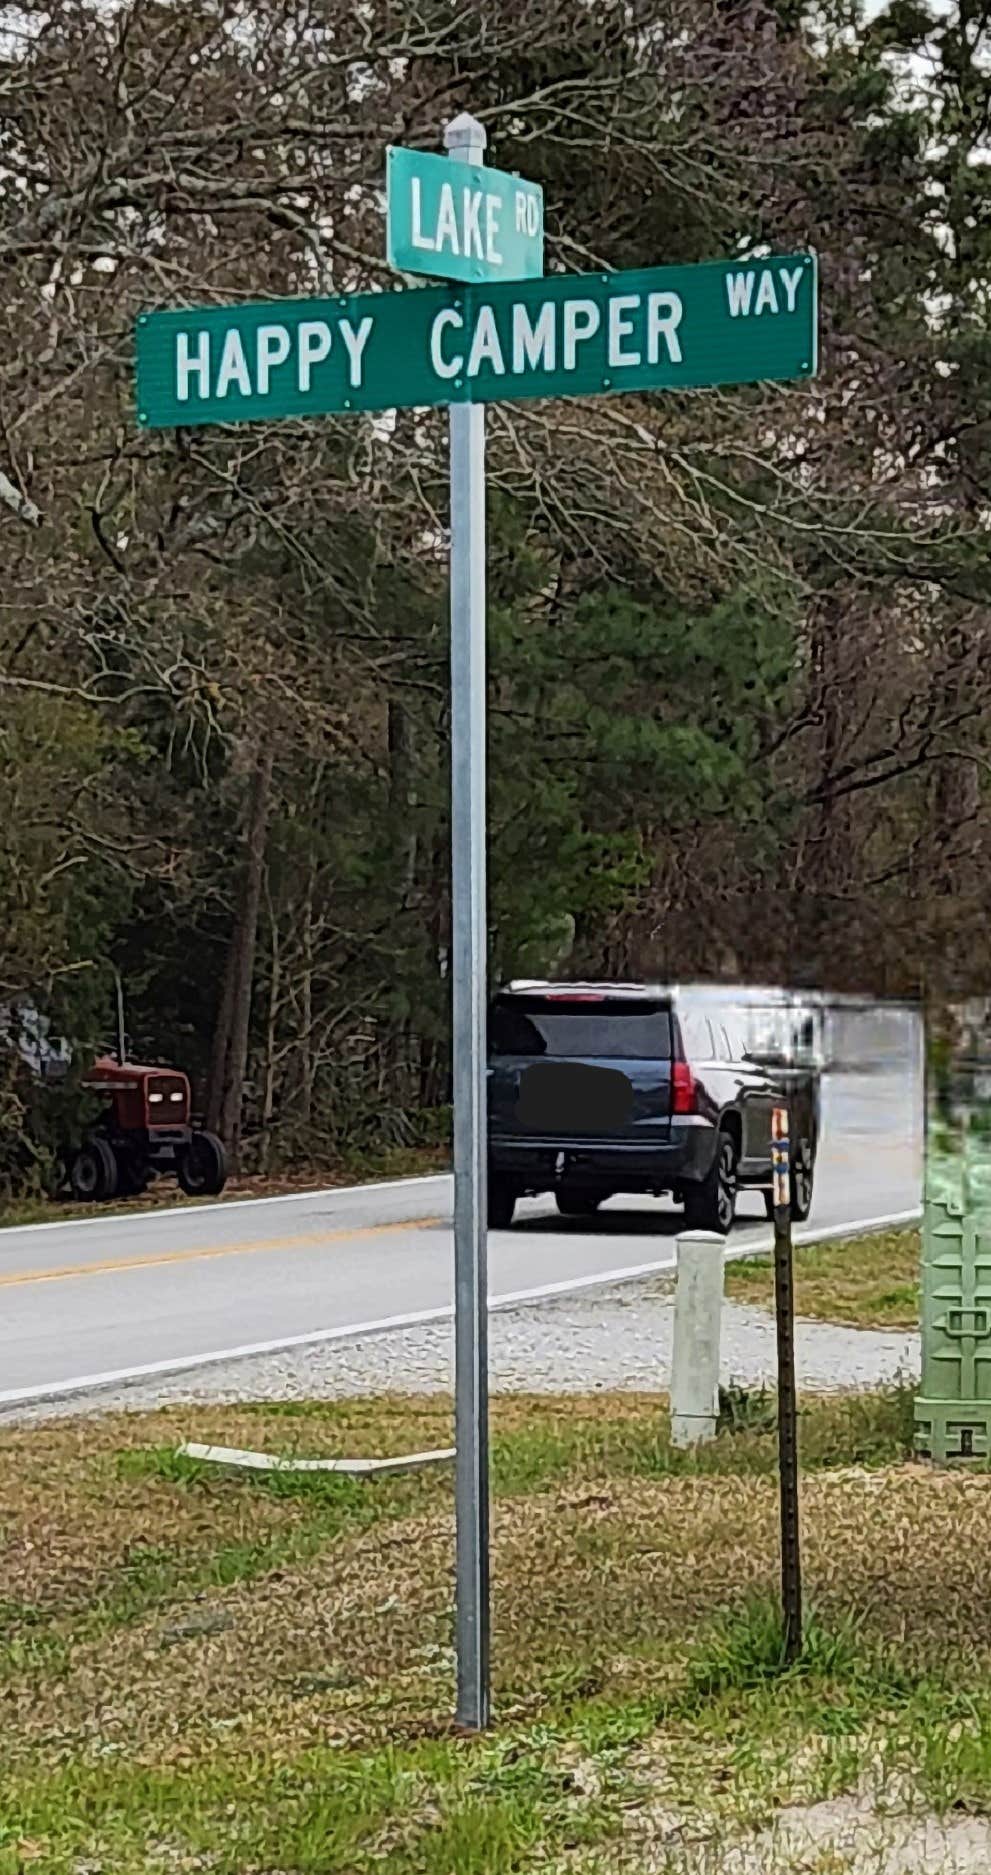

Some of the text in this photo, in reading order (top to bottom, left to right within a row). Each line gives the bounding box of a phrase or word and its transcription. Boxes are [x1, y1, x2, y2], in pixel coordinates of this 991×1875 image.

[410, 176, 539, 265] LAKE RD
[175, 266, 803, 401] HAPPY CAMPER WAY
